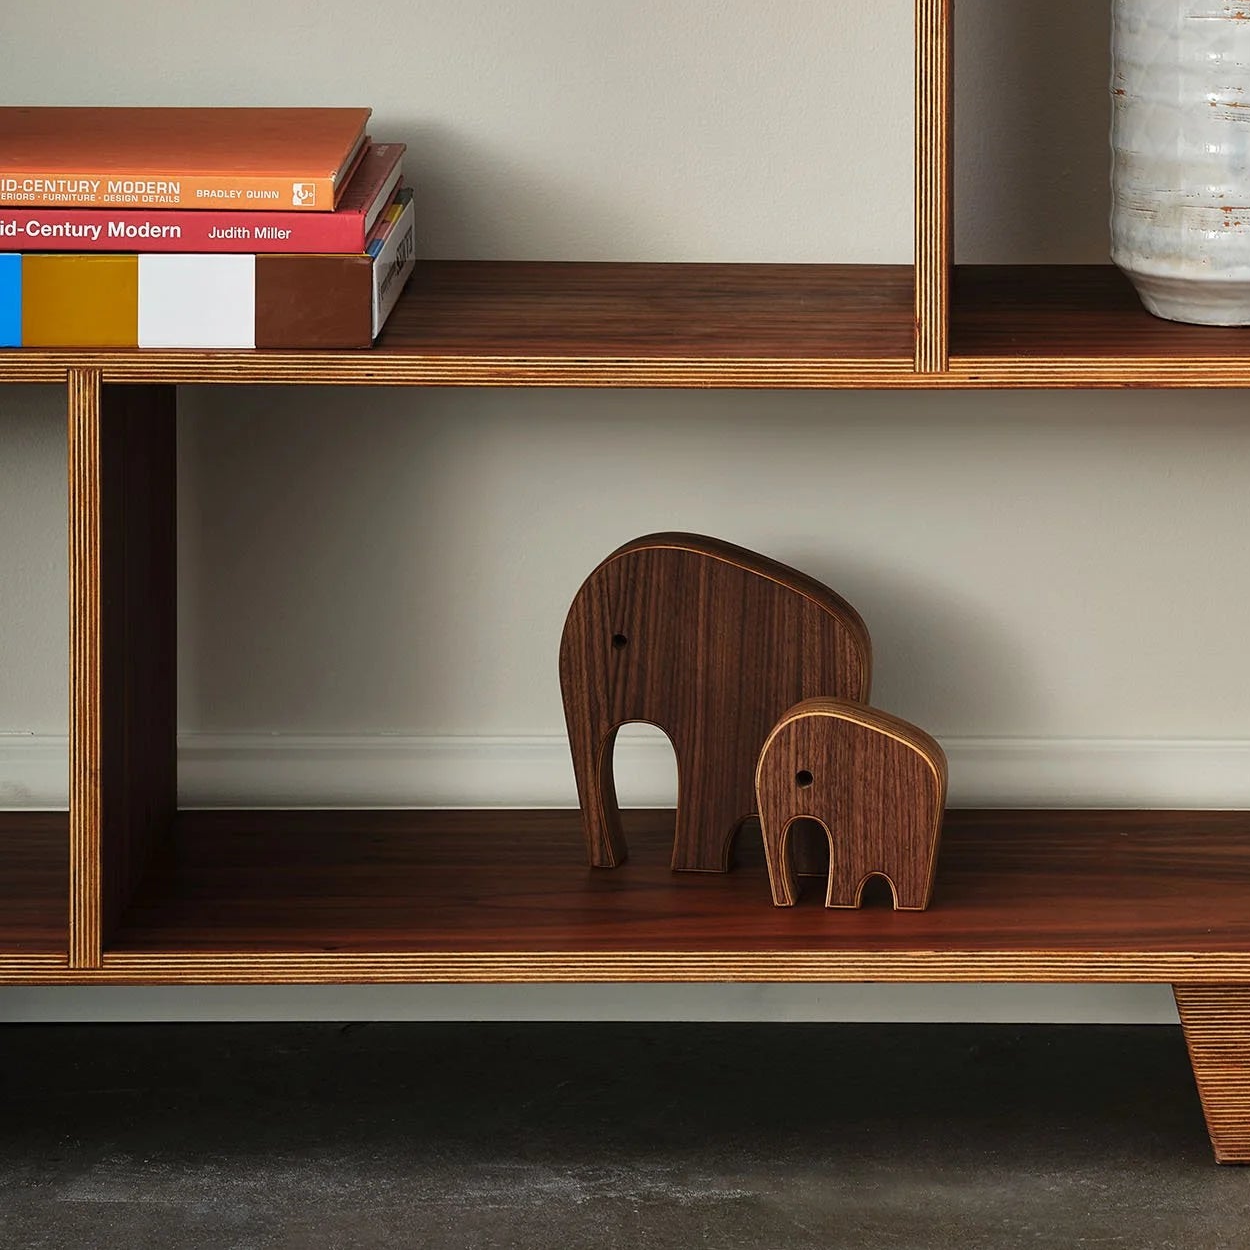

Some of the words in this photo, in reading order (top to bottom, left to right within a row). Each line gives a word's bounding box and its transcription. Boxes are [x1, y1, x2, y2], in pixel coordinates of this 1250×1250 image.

[1, 179, 101, 193] ID-CENTURY
[107, 180, 181, 195] MODERN
[196, 189, 243, 199] BRADLEY
[246, 189, 280, 199] QUINN
[1, 192, 35, 201] ERIORS
[42, 193, 96, 202] FURNITURE
[103, 194, 139, 203] DESIGN
[142, 194, 180, 203] DETAILS
[0, 220, 102, 241] id-Century
[107, 221, 182, 238] Modern
[208, 226, 251, 239] Judith
[254, 227, 292, 240] Miller
